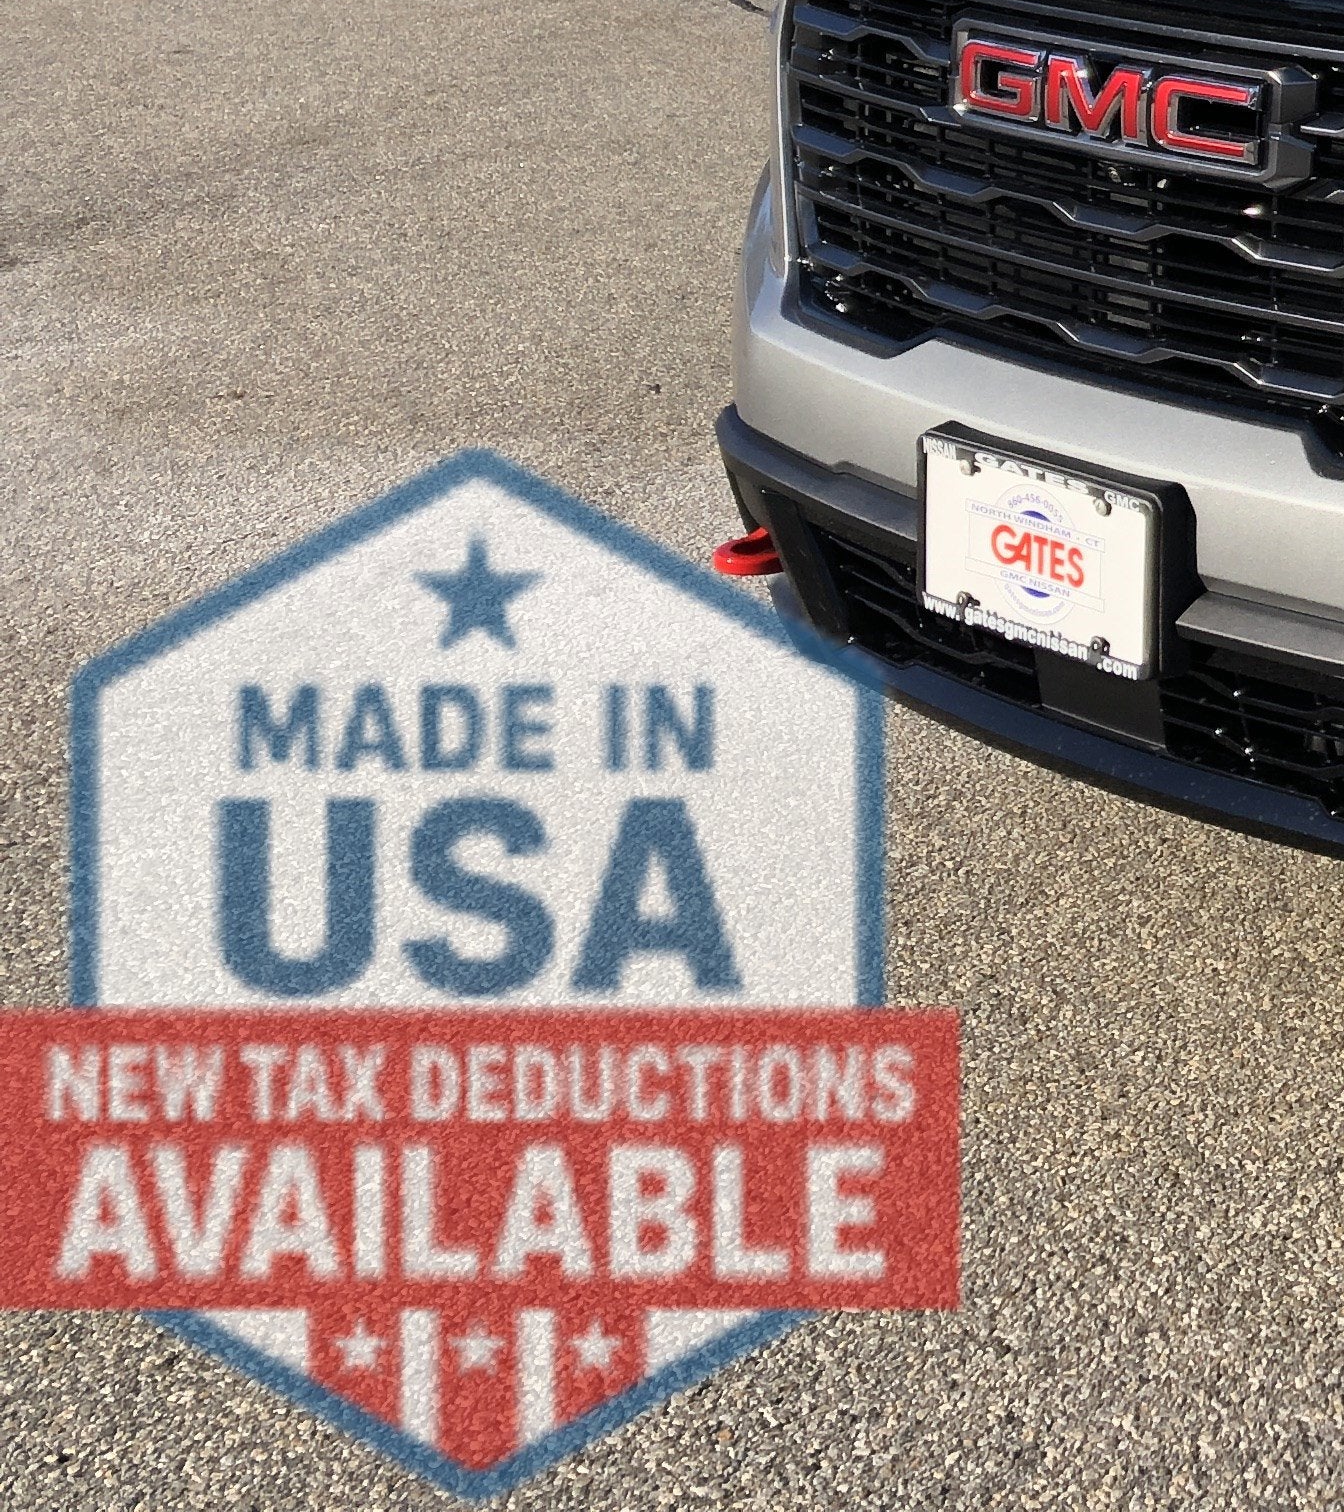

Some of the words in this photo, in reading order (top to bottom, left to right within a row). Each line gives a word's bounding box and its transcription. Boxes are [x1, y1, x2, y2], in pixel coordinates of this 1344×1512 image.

[958, 38, 1261, 167] GMC
[922, 437, 957, 461] NISSAN
[973, 451, 1089, 494] GATES
[1103, 490, 1141, 513] GMC
[970, 503, 1011, 520] NORTH
[1014, 515, 1072, 539] WINDHAM
[1085, 537, 1100, 548] CT
[991, 524, 1085, 588] GATES
[1000, 569, 1027, 584] GMC
[1028, 578, 1071, 598] NISSAN
